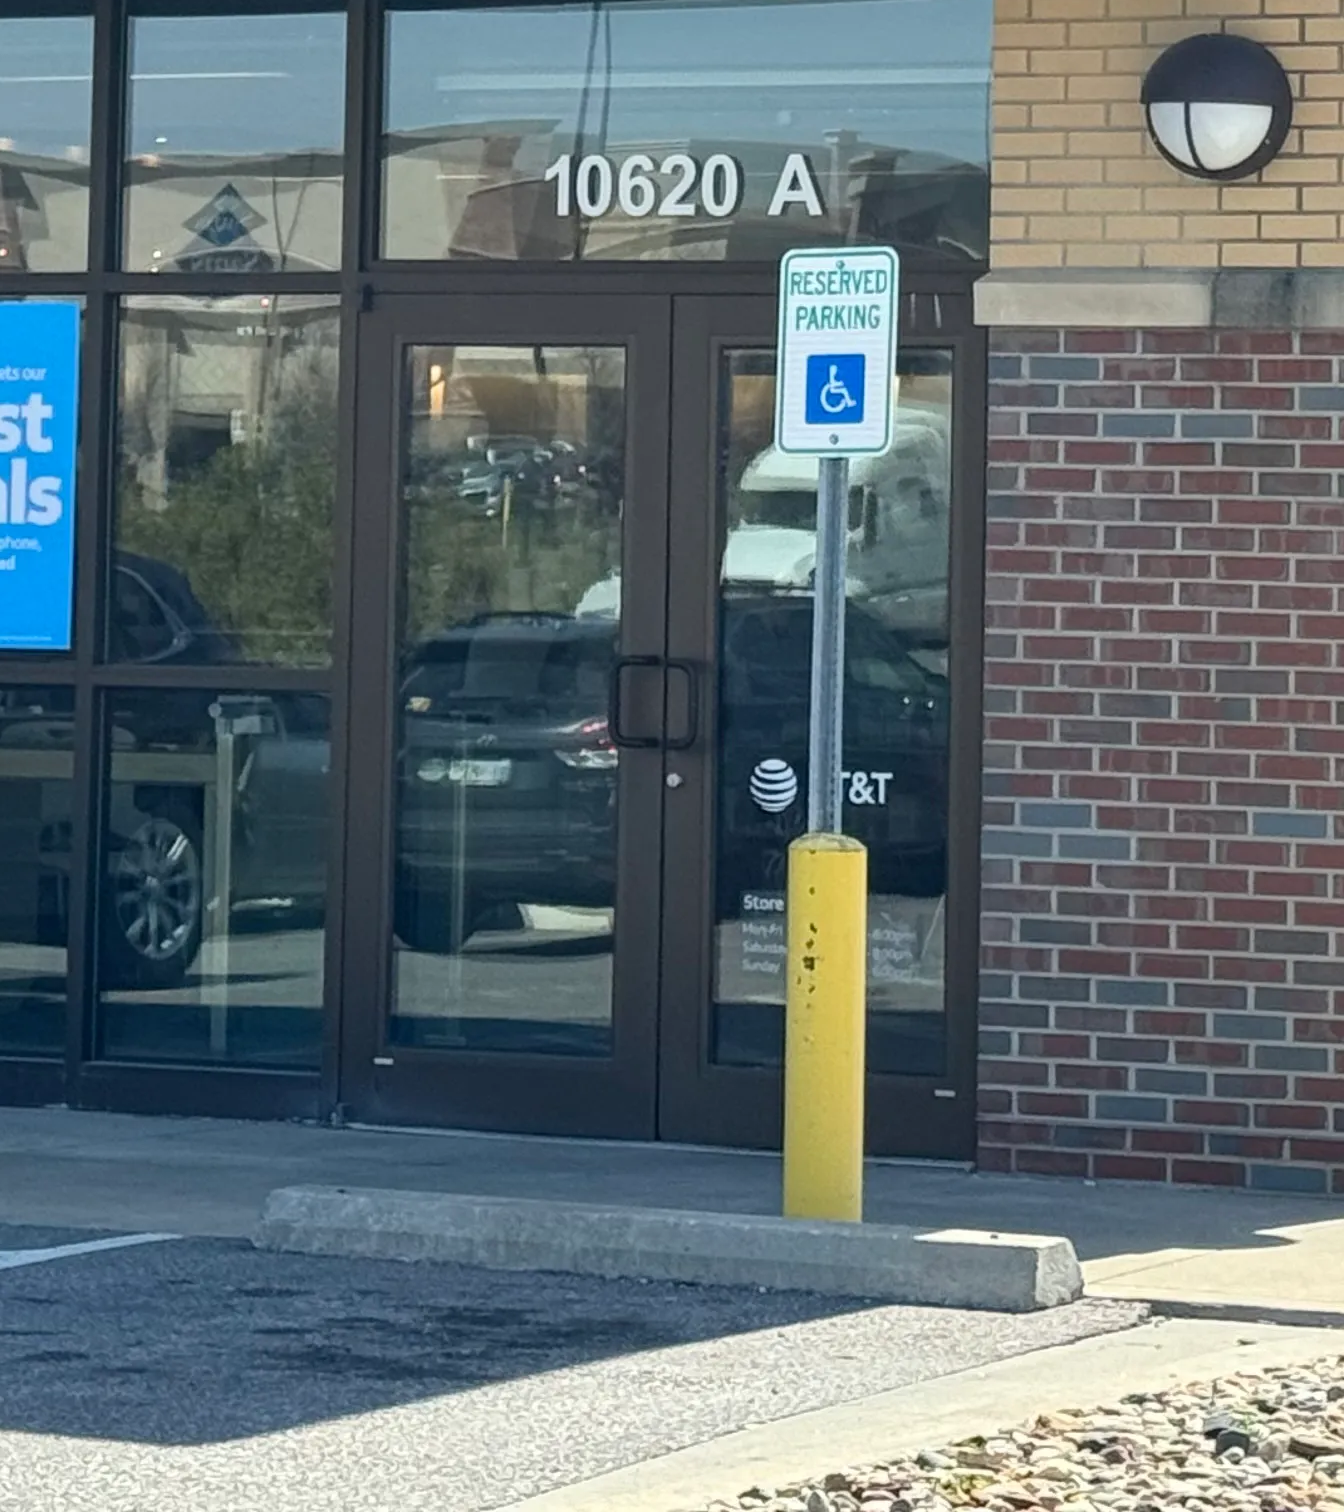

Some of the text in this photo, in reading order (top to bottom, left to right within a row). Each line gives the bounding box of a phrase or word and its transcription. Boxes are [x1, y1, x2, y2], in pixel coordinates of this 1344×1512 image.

[545, 153, 824, 218] 10620 A
[789, 268, 888, 296] RESERVED
[795, 304, 881, 332] PARKING
[22, 367, 47, 381] our
[840, 771, 894, 805] T&T
[743, 893, 785, 912] Store
